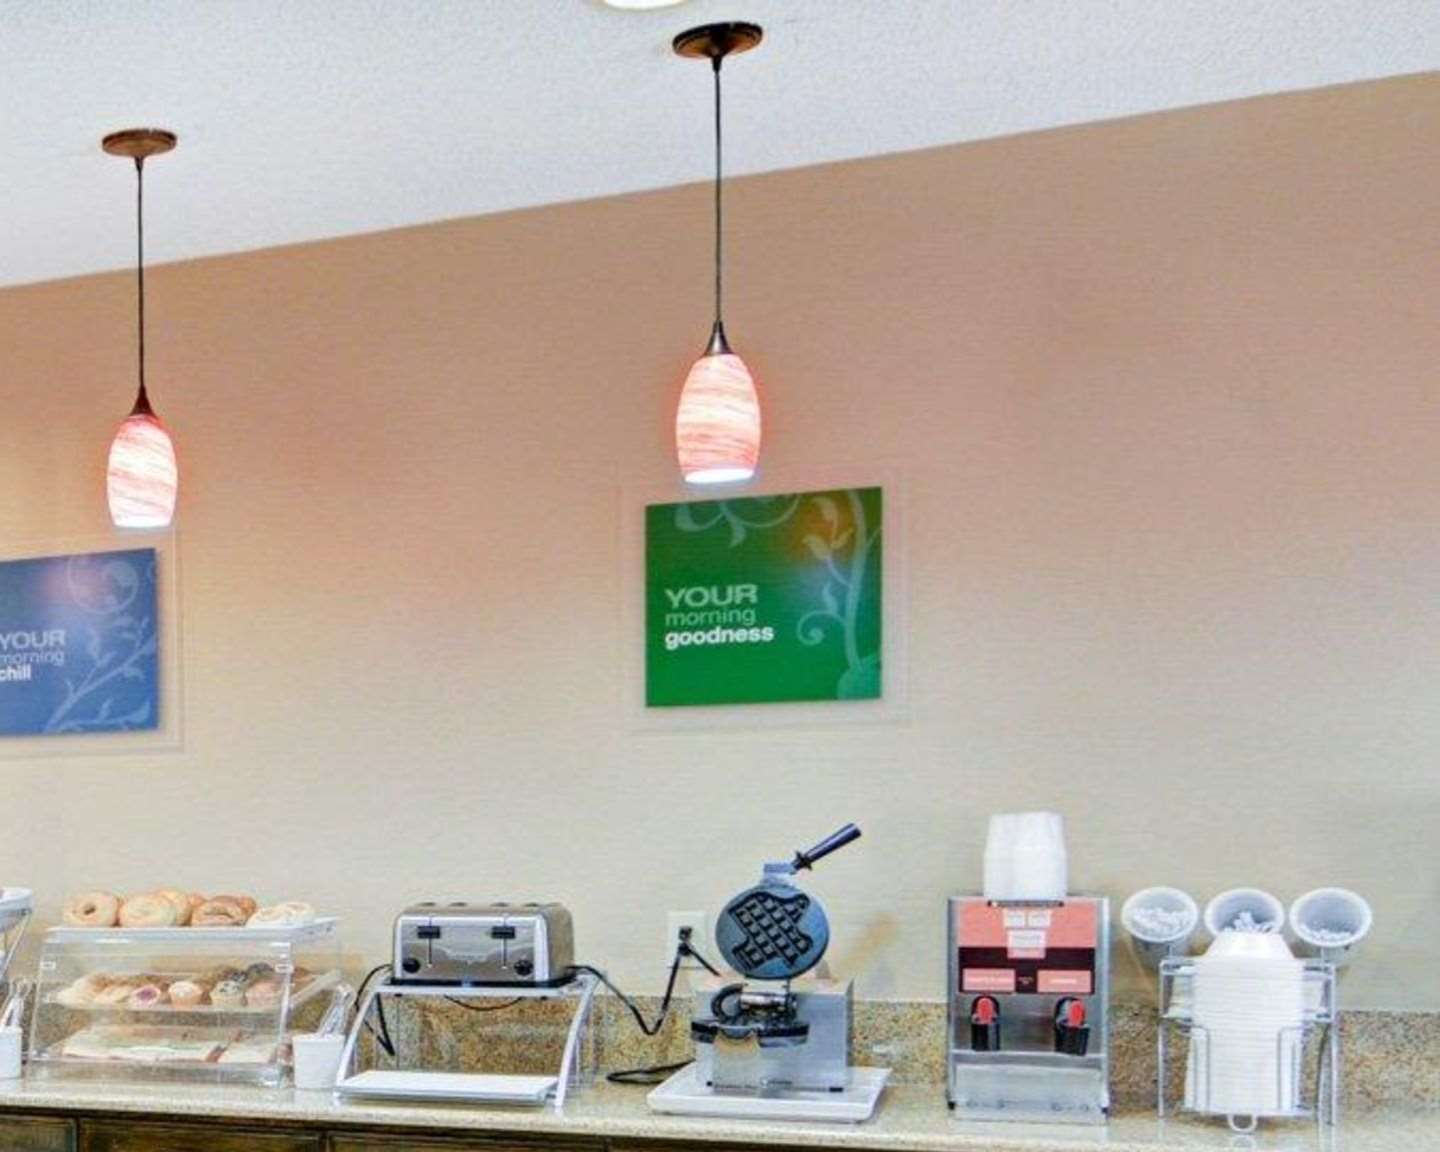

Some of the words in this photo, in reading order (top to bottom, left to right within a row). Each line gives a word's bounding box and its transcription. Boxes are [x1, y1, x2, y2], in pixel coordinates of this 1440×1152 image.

[665, 584, 758, 608] YOUR
[665, 608, 756, 627] morning
[665, 626, 774, 650] goodness
